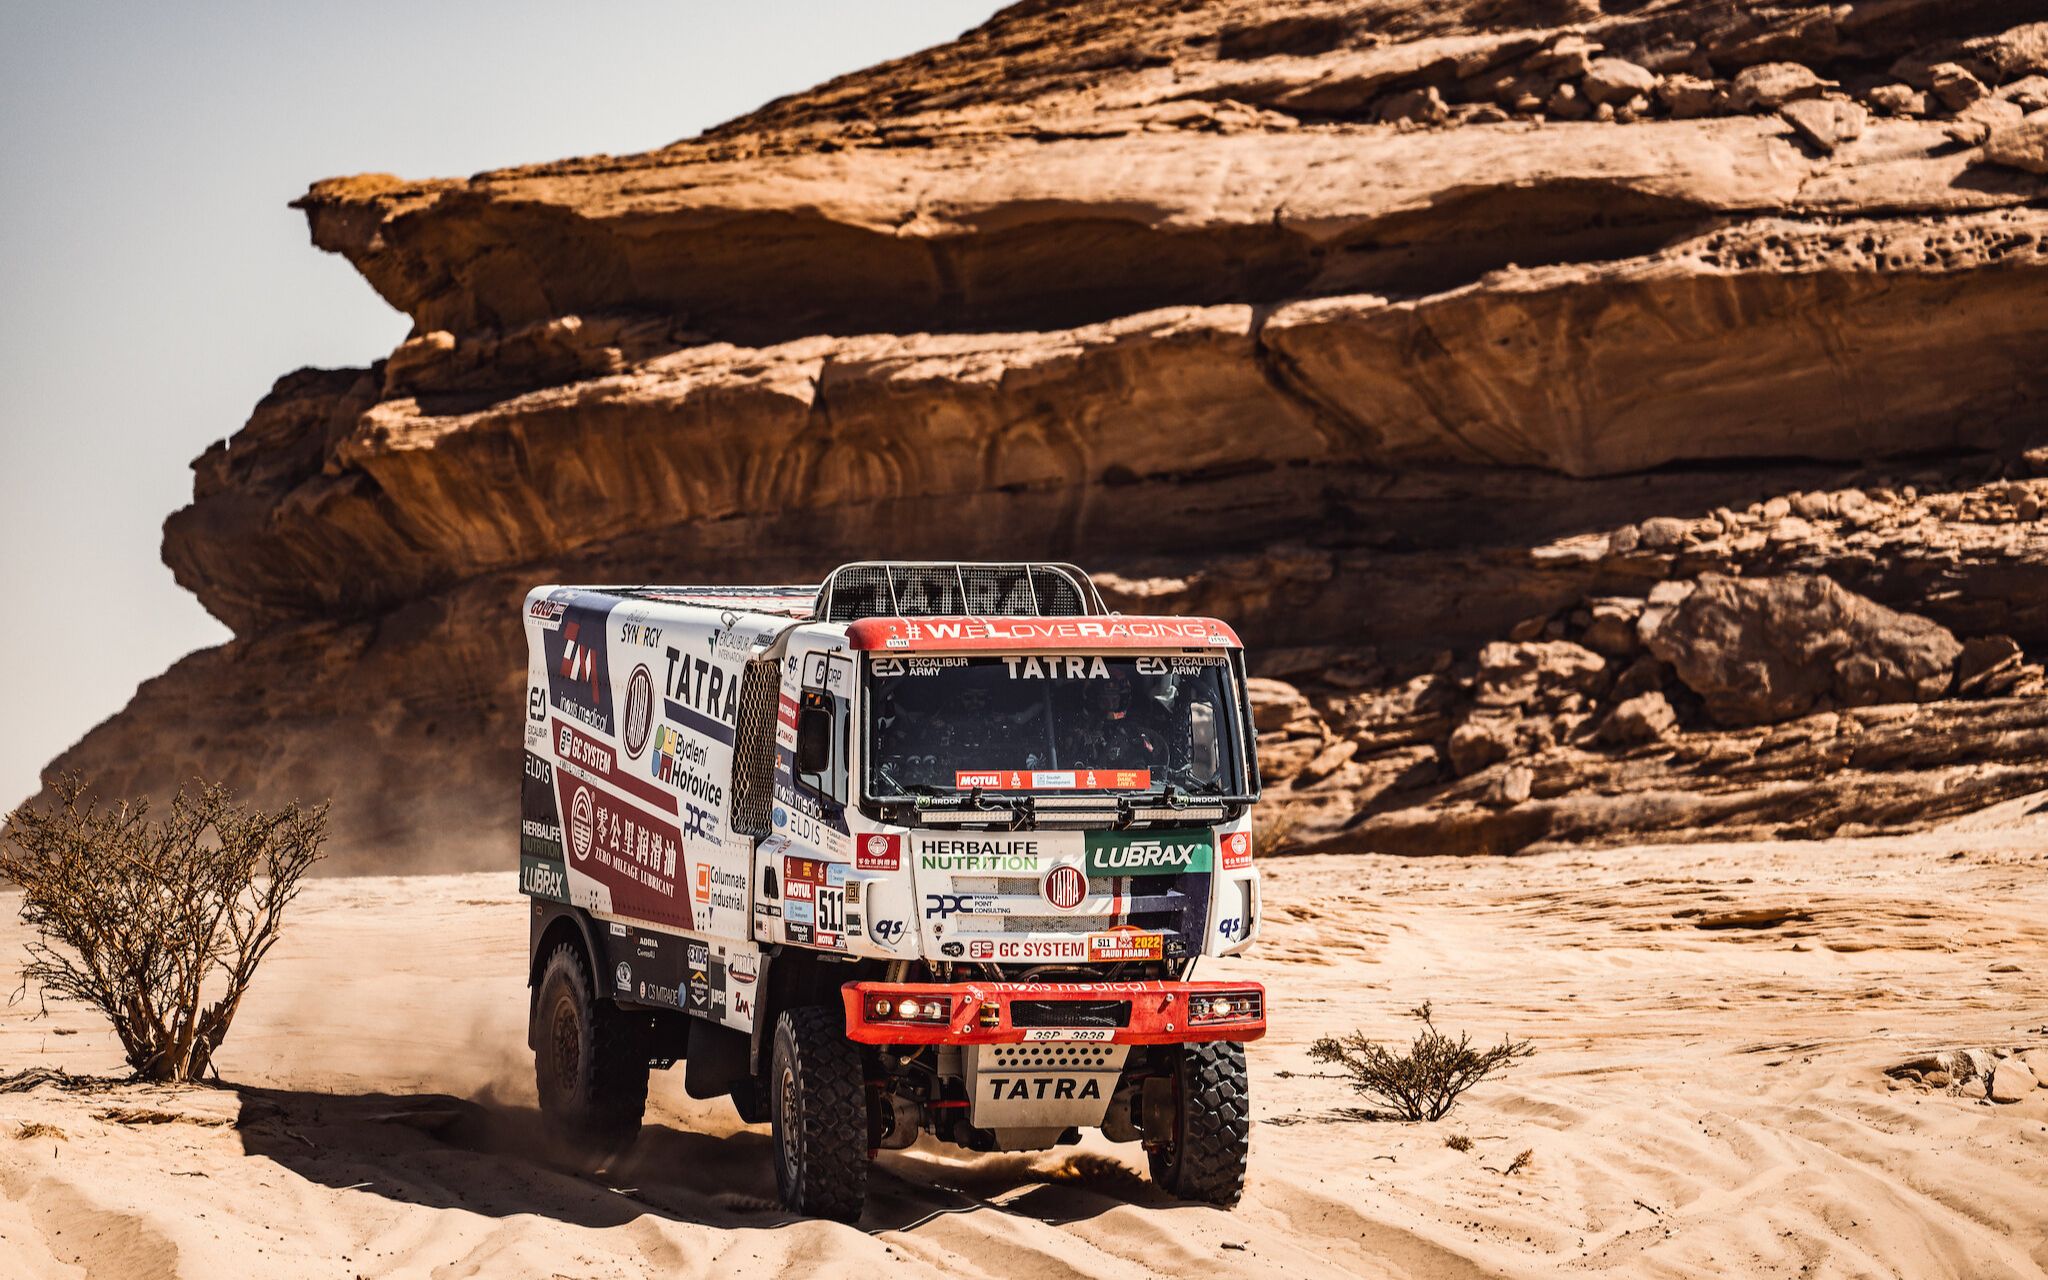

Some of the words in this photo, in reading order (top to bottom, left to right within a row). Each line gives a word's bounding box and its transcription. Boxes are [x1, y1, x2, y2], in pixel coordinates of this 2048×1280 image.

[530, 600, 555, 616] GOLD
[908, 658, 969, 668] EXCALIBUR
[909, 667, 940, 676] ARMY
[1002, 656, 1111, 680] TATRA
[1171, 657, 1227, 667] EXCALIBUR
[1172, 666, 1202, 675] ARMY
[665, 646, 738, 725] TATRA
[527, 724, 548, 738] EXCALIBUR
[572, 736, 583, 760] GC
[582, 741, 611, 775] SYSTEM
[676, 733, 709, 767] Bydlení
[525, 754, 551, 784] ELDIS
[671, 761, 722, 807] Hořovice
[960, 776, 999, 786] MOTUL
[932, 797, 962, 805] ARDON
[523, 820, 560, 843] HERBALIFE
[790, 812, 820, 846] ELDIS
[523, 837, 560, 860] NUTRITION
[922, 841, 1038, 855] HERBALIFE
[1093, 842, 1195, 868] LUBRAX
[595, 846, 611, 866] ZERO
[612, 855, 639, 881] MILEAGE
[640, 869, 675, 898] LUBRICANT
[922, 856, 1037, 870] NUTRITION
[523, 864, 563, 898] LUBRAX
[710, 866, 746, 890] Columnate
[1052, 869, 1079, 906] TATRA
[711, 888, 745, 912] industrial.
[786, 881, 811, 899] MOTUL
[819, 890, 844, 932] 511
[817, 934, 834, 945] MOTUL
[999, 943, 1021, 957] GC
[1023, 942, 1085, 957] SYSTEM
[1097, 938, 1111, 947] 511
[1134, 936, 1160, 949] 2022
[1101, 949, 1122, 958] SAUDI
[1123, 948, 1150, 957] ARABIA
[1034, 1031, 1061, 1040] 3SP
[990, 1078, 1101, 1100] TATRA
